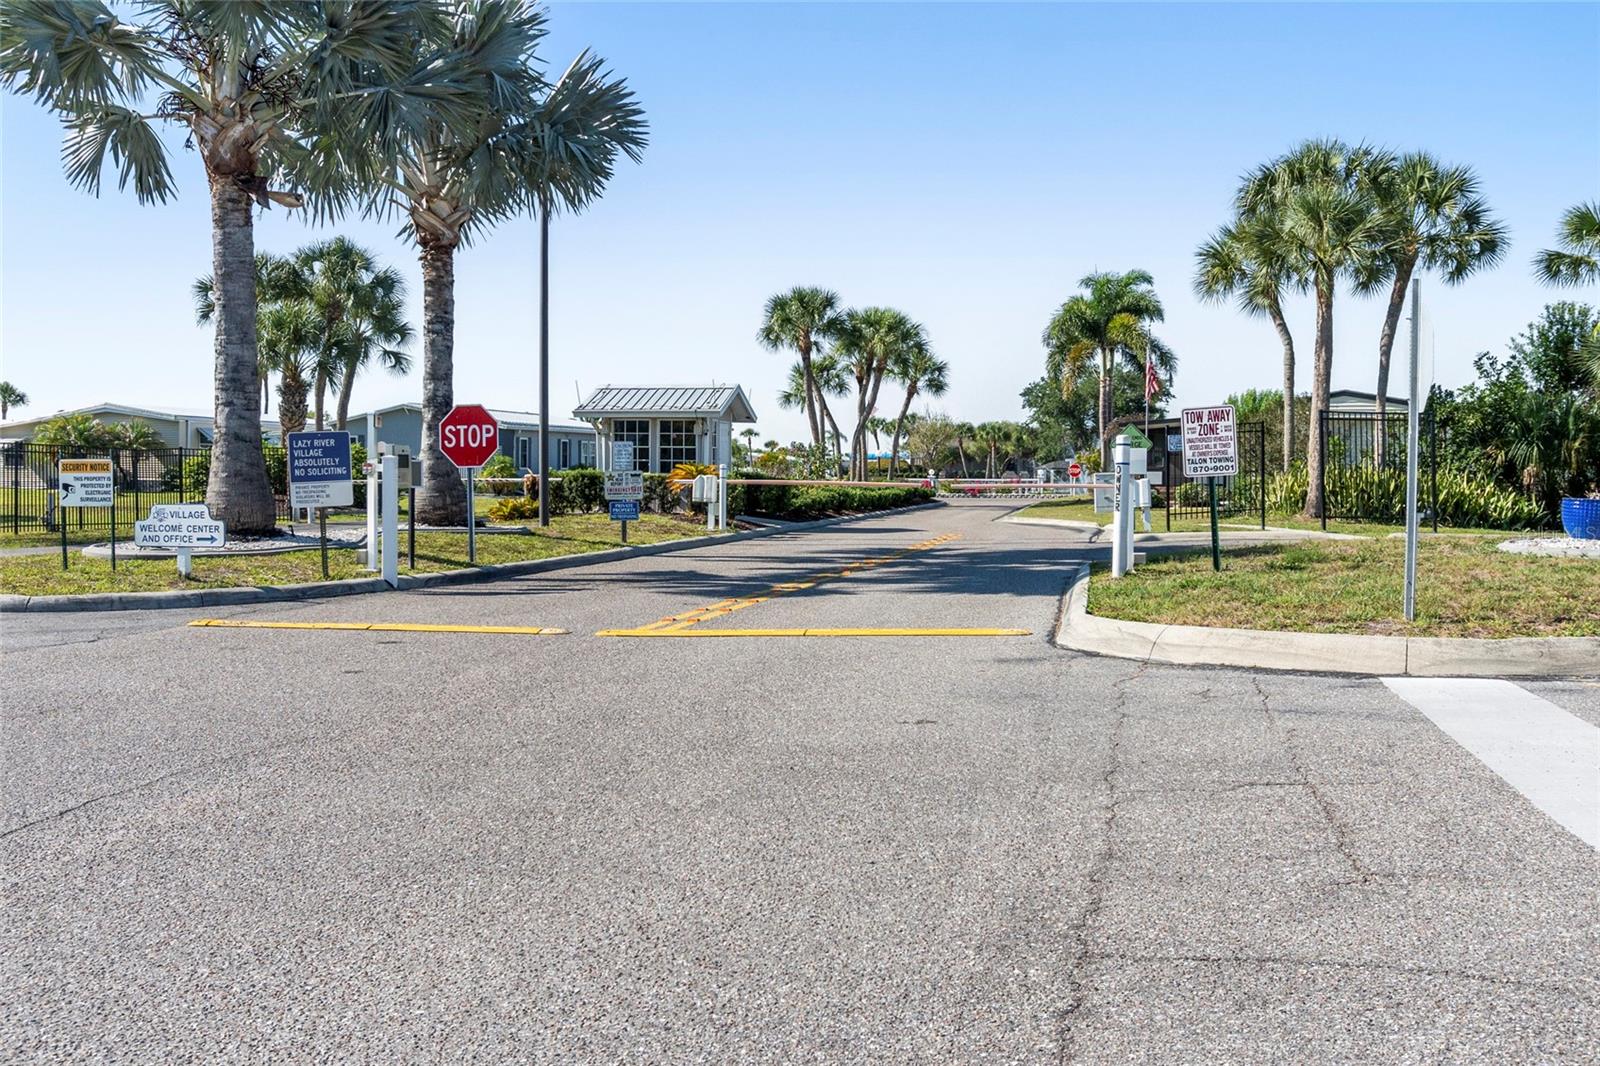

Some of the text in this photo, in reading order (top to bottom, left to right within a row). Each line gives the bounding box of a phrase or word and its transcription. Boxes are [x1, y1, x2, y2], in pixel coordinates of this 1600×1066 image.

[1185, 409, 1231, 424] TOW AWAY
[1198, 423, 1220, 436] ZONE
[444, 424, 495, 448] STOP
[293, 439, 336, 448] LAZY RIVER
[293, 448, 324, 457] VILLAGE
[294, 458, 340, 466] ABSOLUTELY
[1208, 456, 1234, 464] TOWING
[62, 464, 110, 472] SECURITY NOTICE
[294, 467, 348, 476] NO SOLICITING
[1192, 464, 1234, 473] 870-9001
[170, 510, 206, 519] VILLAGE
[140, 524, 220, 533] WELCOME CENTER
[142, 534, 194, 543] AND OFFICE
